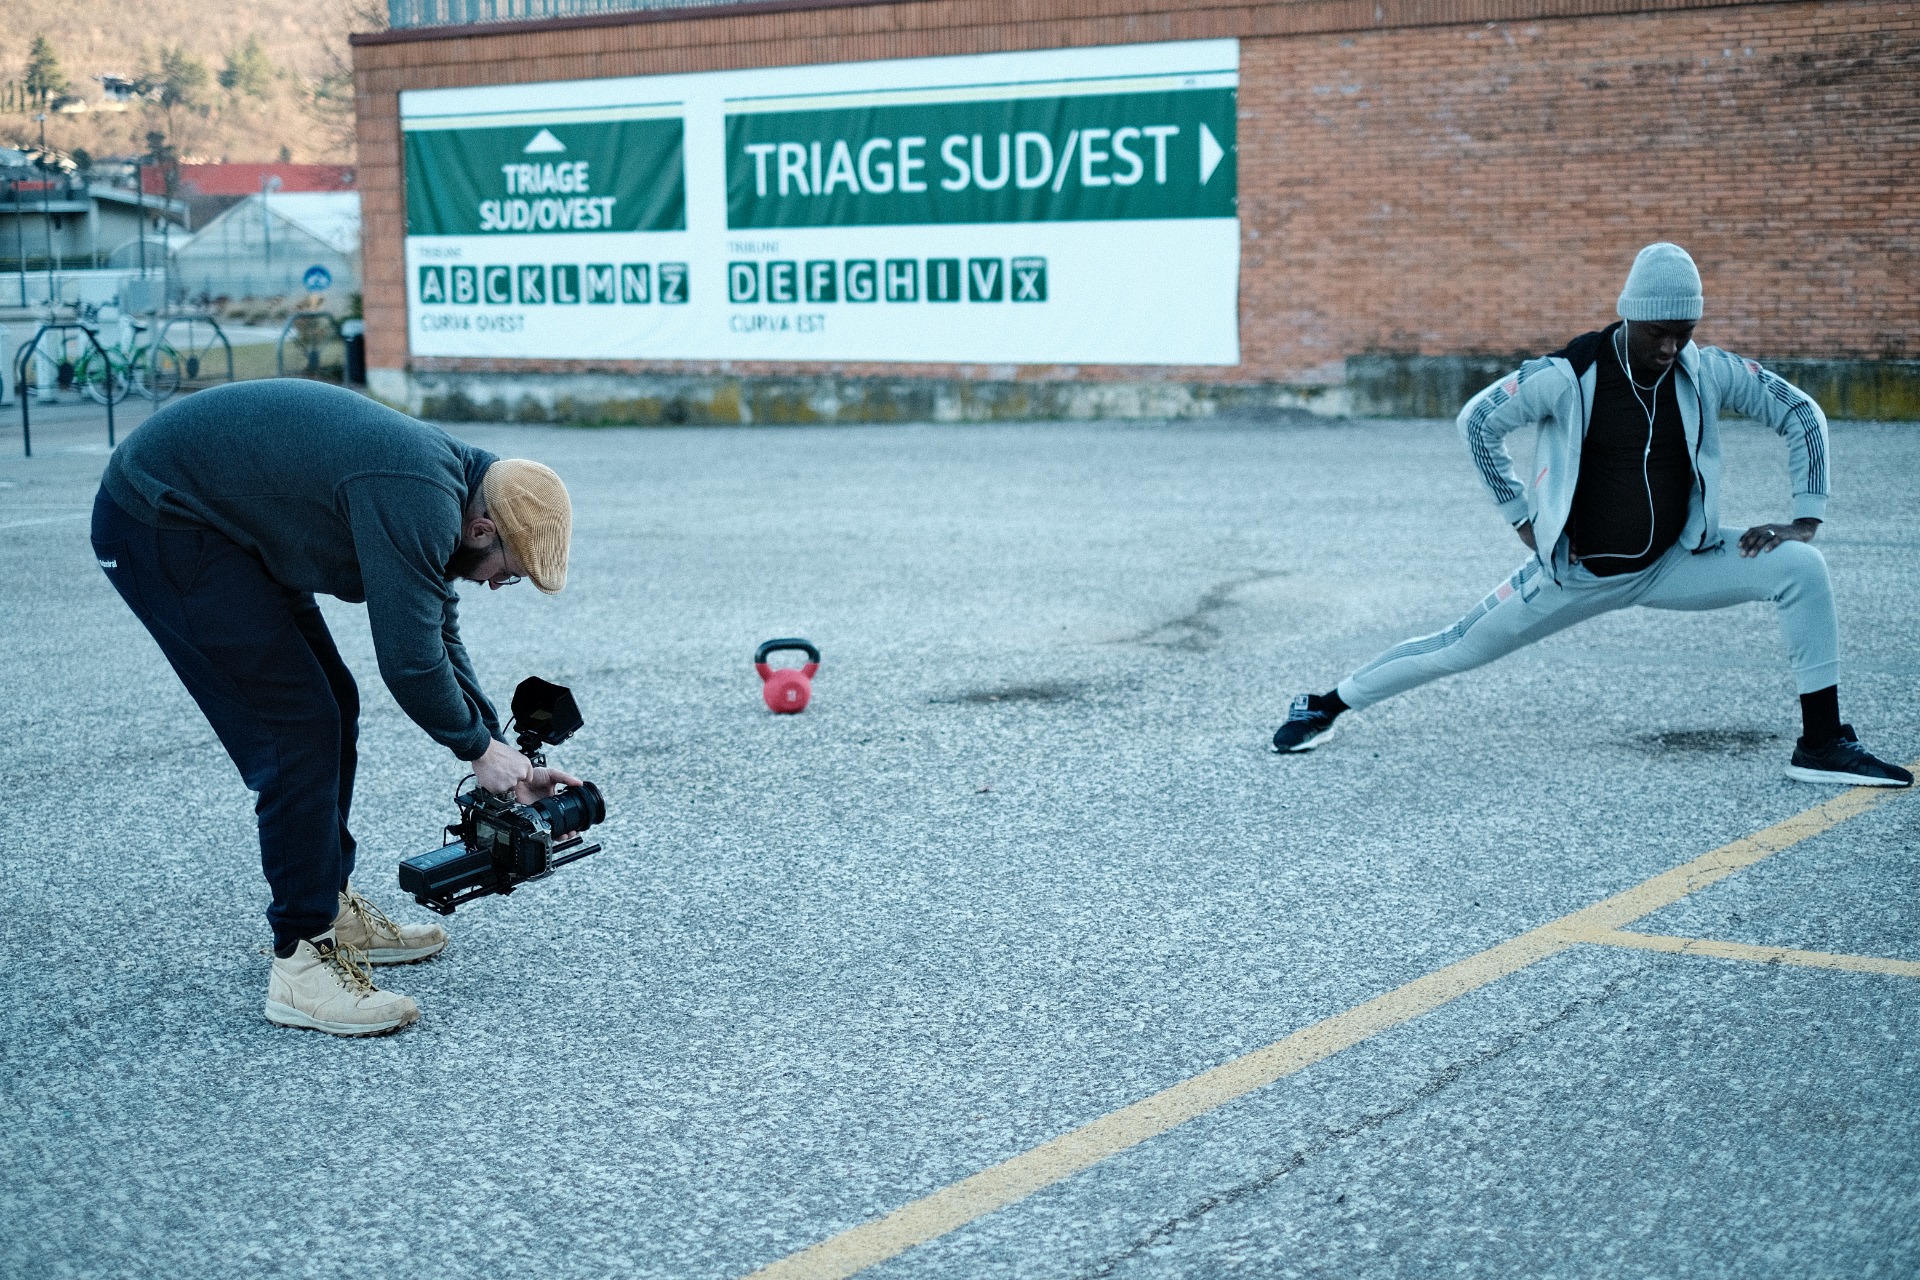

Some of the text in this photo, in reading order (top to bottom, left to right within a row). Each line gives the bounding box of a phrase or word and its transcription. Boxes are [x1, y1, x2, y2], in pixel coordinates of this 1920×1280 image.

[501, 161, 590, 194] TRIAGE
[743, 125, 1181, 198] TRIAGE SUD/EST
[479, 196, 617, 231] SUD/OVEST
[420, 267, 683, 303] A B C K L M N Z
[731, 261, 1040, 301] D E F G H I V X
[420, 313, 525, 333] CURVA OVEST
[729, 313, 826, 333] CURVA EST
